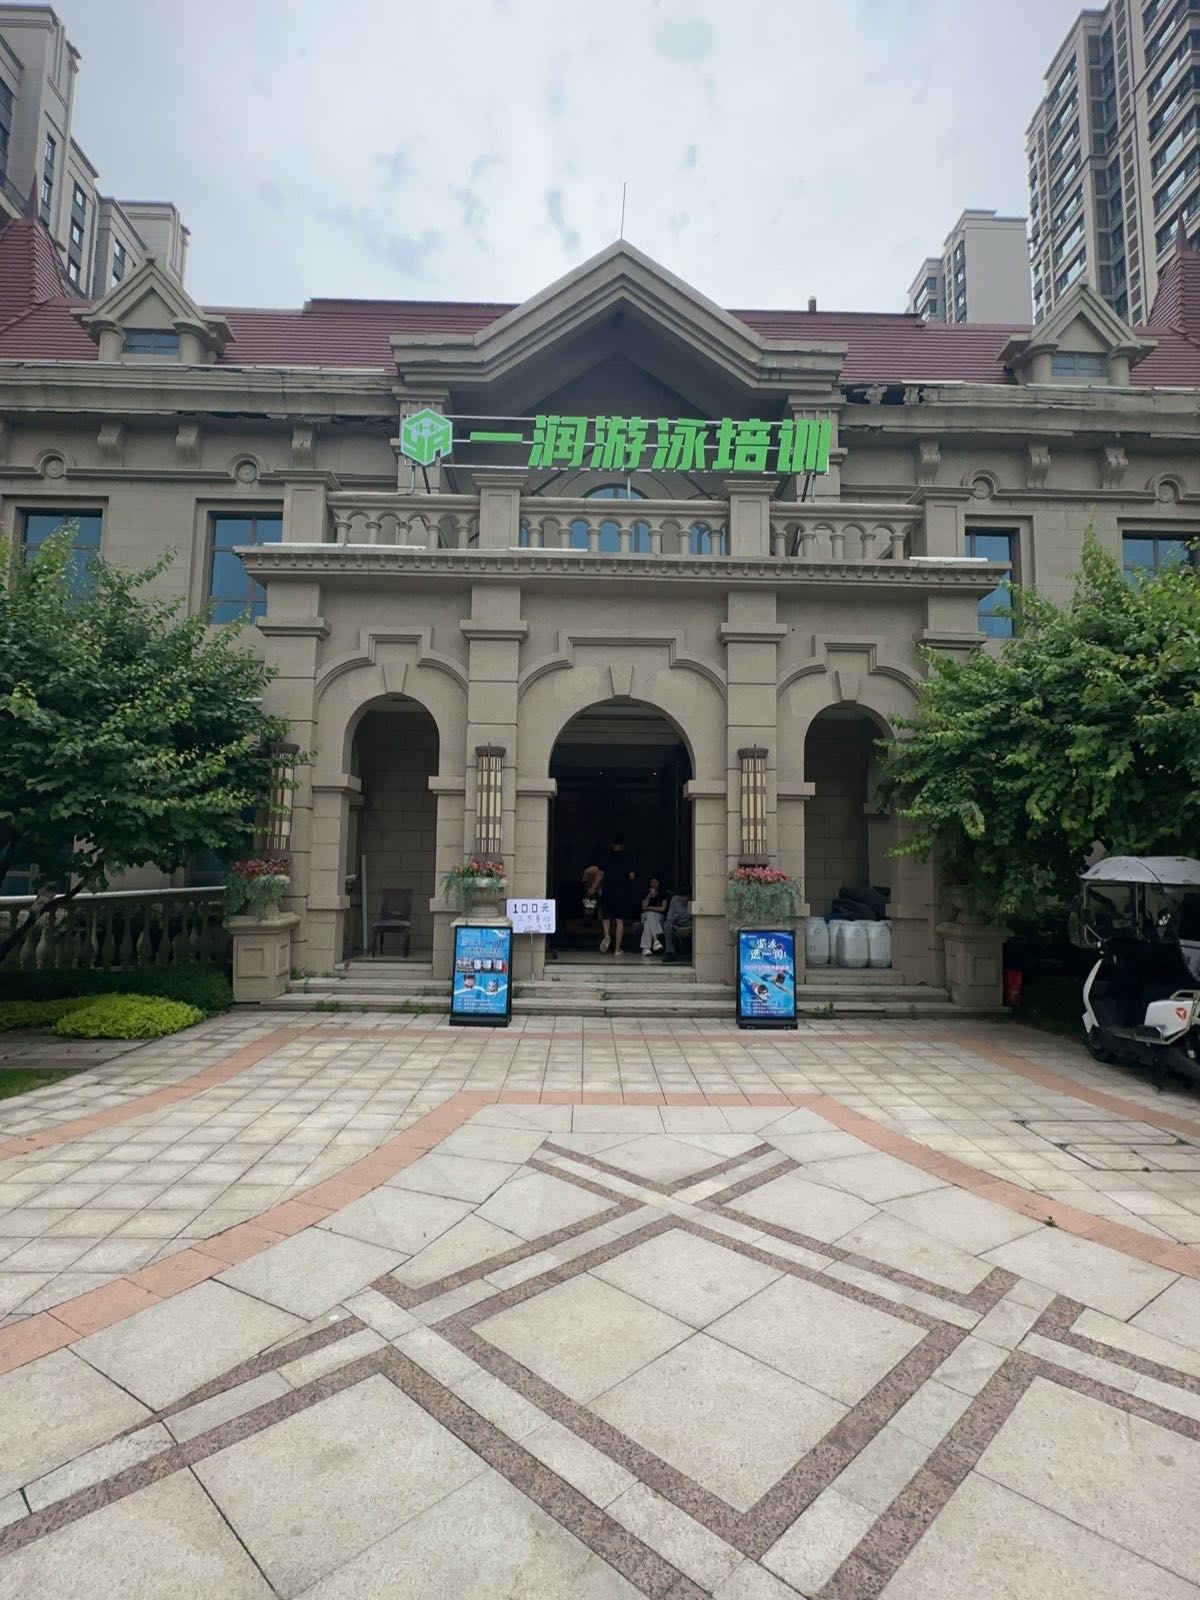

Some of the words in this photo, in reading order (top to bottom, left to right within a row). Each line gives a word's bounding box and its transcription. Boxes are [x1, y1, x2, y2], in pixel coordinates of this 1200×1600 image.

[469, 415, 832, 474] 一润游泳培训
[513, 902, 550, 914] 100元
